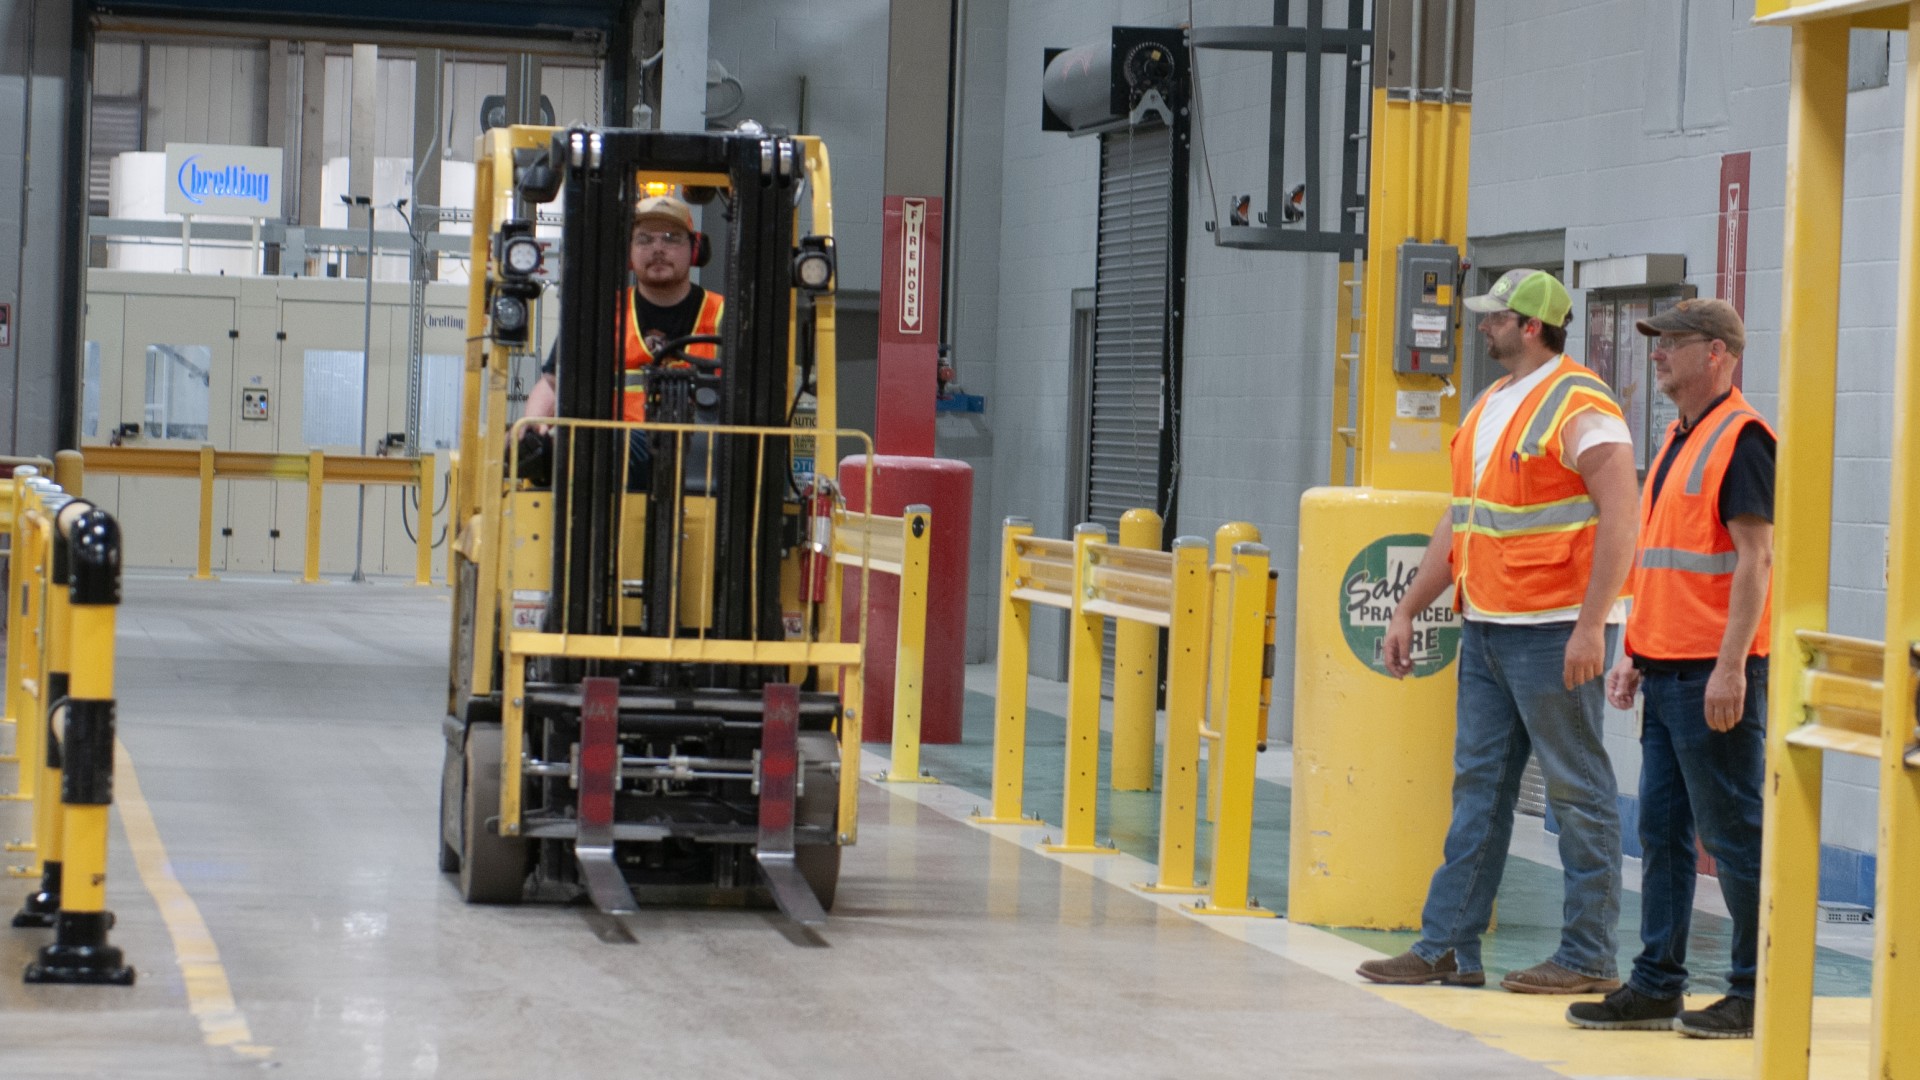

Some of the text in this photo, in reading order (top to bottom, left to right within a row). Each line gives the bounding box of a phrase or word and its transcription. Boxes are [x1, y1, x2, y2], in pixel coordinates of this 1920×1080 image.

[907, 210, 918, 317] FIRE HOSE
[1360, 605, 1454, 623] PRAICED
[1375, 626, 1438, 660] HRE
